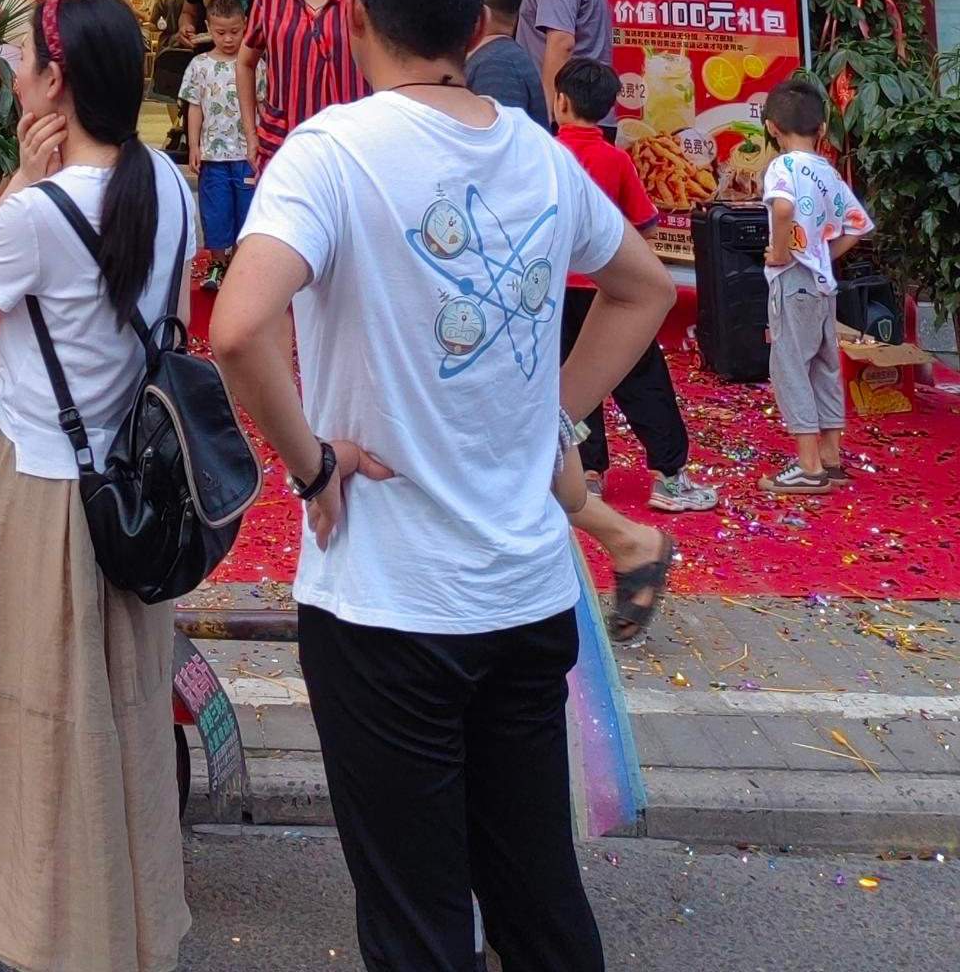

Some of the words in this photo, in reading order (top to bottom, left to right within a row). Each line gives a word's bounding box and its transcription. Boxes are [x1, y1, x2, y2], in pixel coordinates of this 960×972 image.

[613, 0, 788, 34] 价值100元礼包
[801, 165, 829, 197] DUCK
